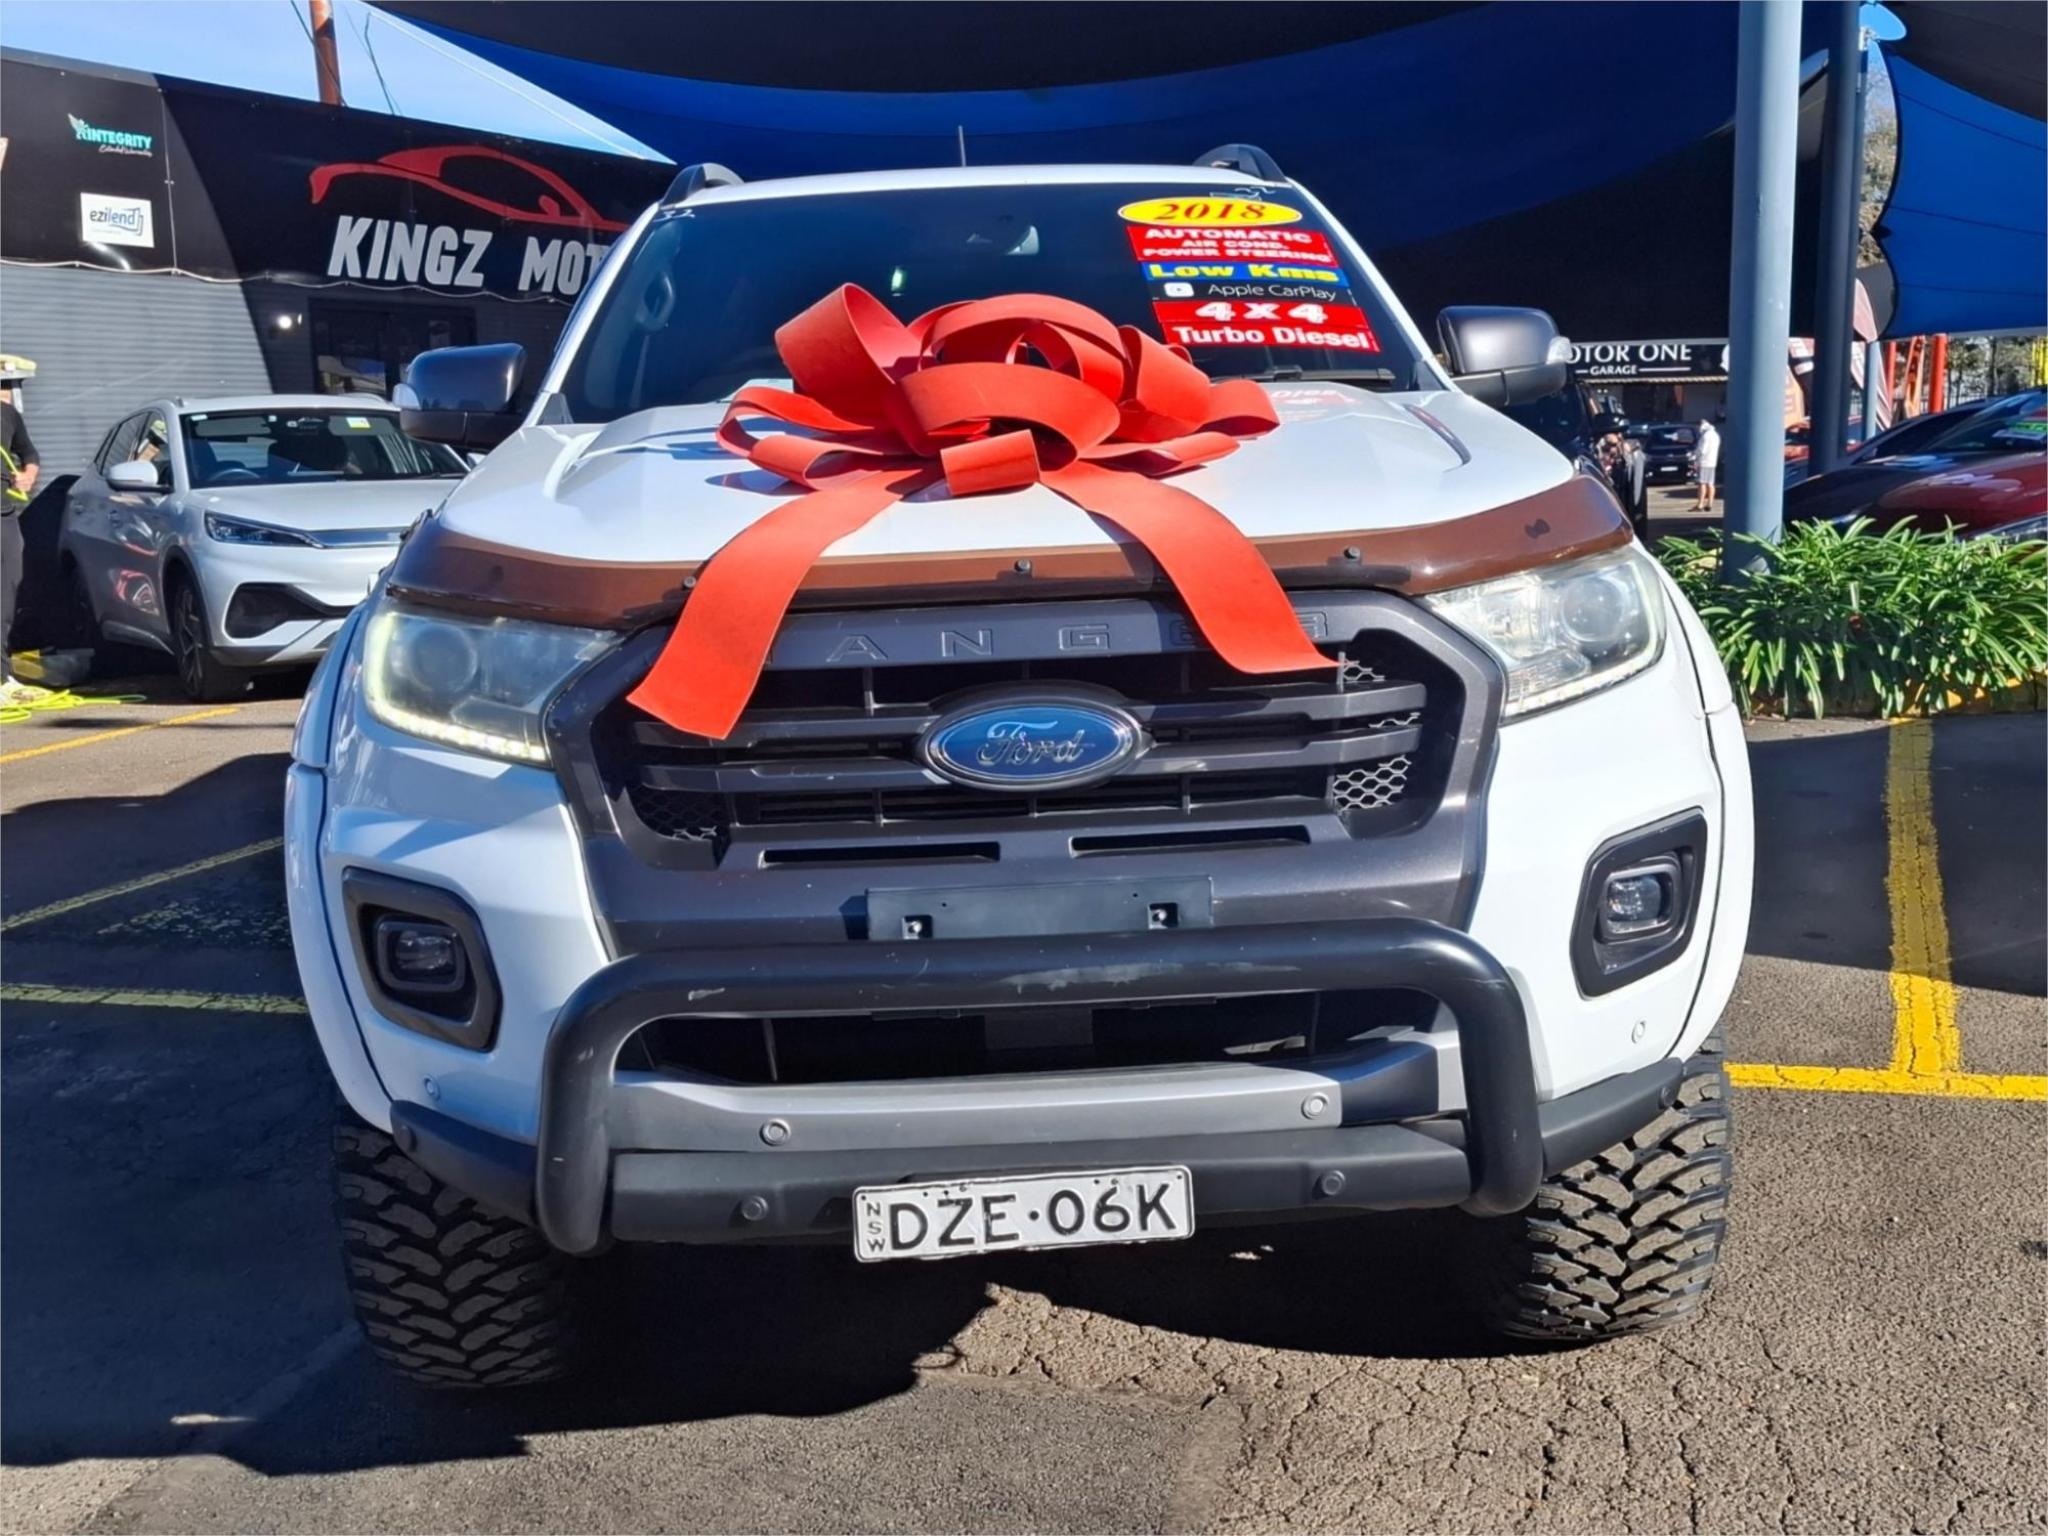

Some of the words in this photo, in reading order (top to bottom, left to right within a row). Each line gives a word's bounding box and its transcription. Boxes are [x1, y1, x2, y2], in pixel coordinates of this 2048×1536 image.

[87, 128, 152, 149] INTEGRITY
[90, 207, 136, 225] ezilend
[1155, 202, 1266, 220] 2018
[1145, 228, 1312, 243] AUTOMATIC
[1182, 240, 1218, 248] AIR
[327, 215, 493, 287] KINGZ
[1143, 248, 1219, 257] POWER
[1225, 249, 1332, 262] STEERING
[1208, 284, 1264, 296] Apple
[1269, 285, 1336, 301] CarPlay
[1172, 327, 1264, 343] Turbo
[1274, 328, 1369, 348] Diesel
[1565, 343, 1630, 364] OTOR
[1639, 343, 1692, 362] ONE
[1590, 365, 1637, 376] GARAGE
[975, 720, 1084, 768] Ford
